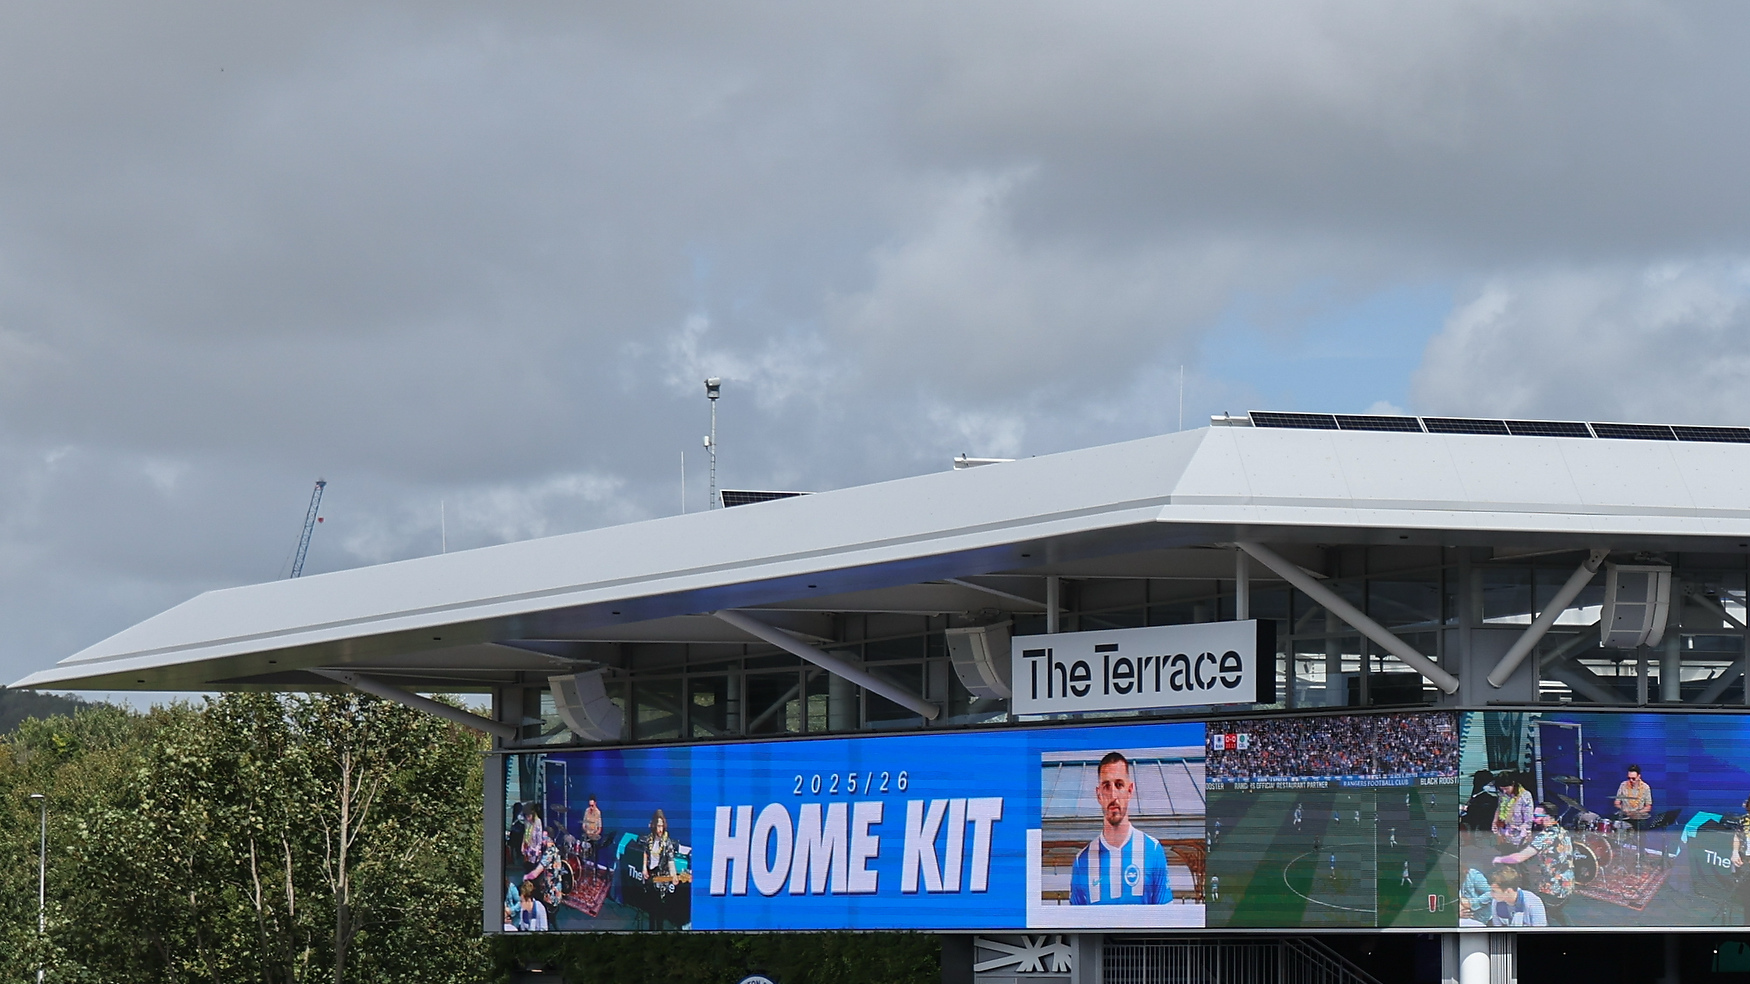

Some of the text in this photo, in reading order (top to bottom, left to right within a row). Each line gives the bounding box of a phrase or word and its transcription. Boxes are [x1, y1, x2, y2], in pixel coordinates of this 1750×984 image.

[1023, 643, 1243, 700] The Terrace
[793, 771, 908, 794] 2025/26
[1306, 781, 1328, 789] PARTNER
[1420, 777, 1459, 786] BLACK ROOST
[710, 797, 1003, 896] HOME KIT
[1704, 849, 1731, 868] The
[628, 864, 643, 881] The
